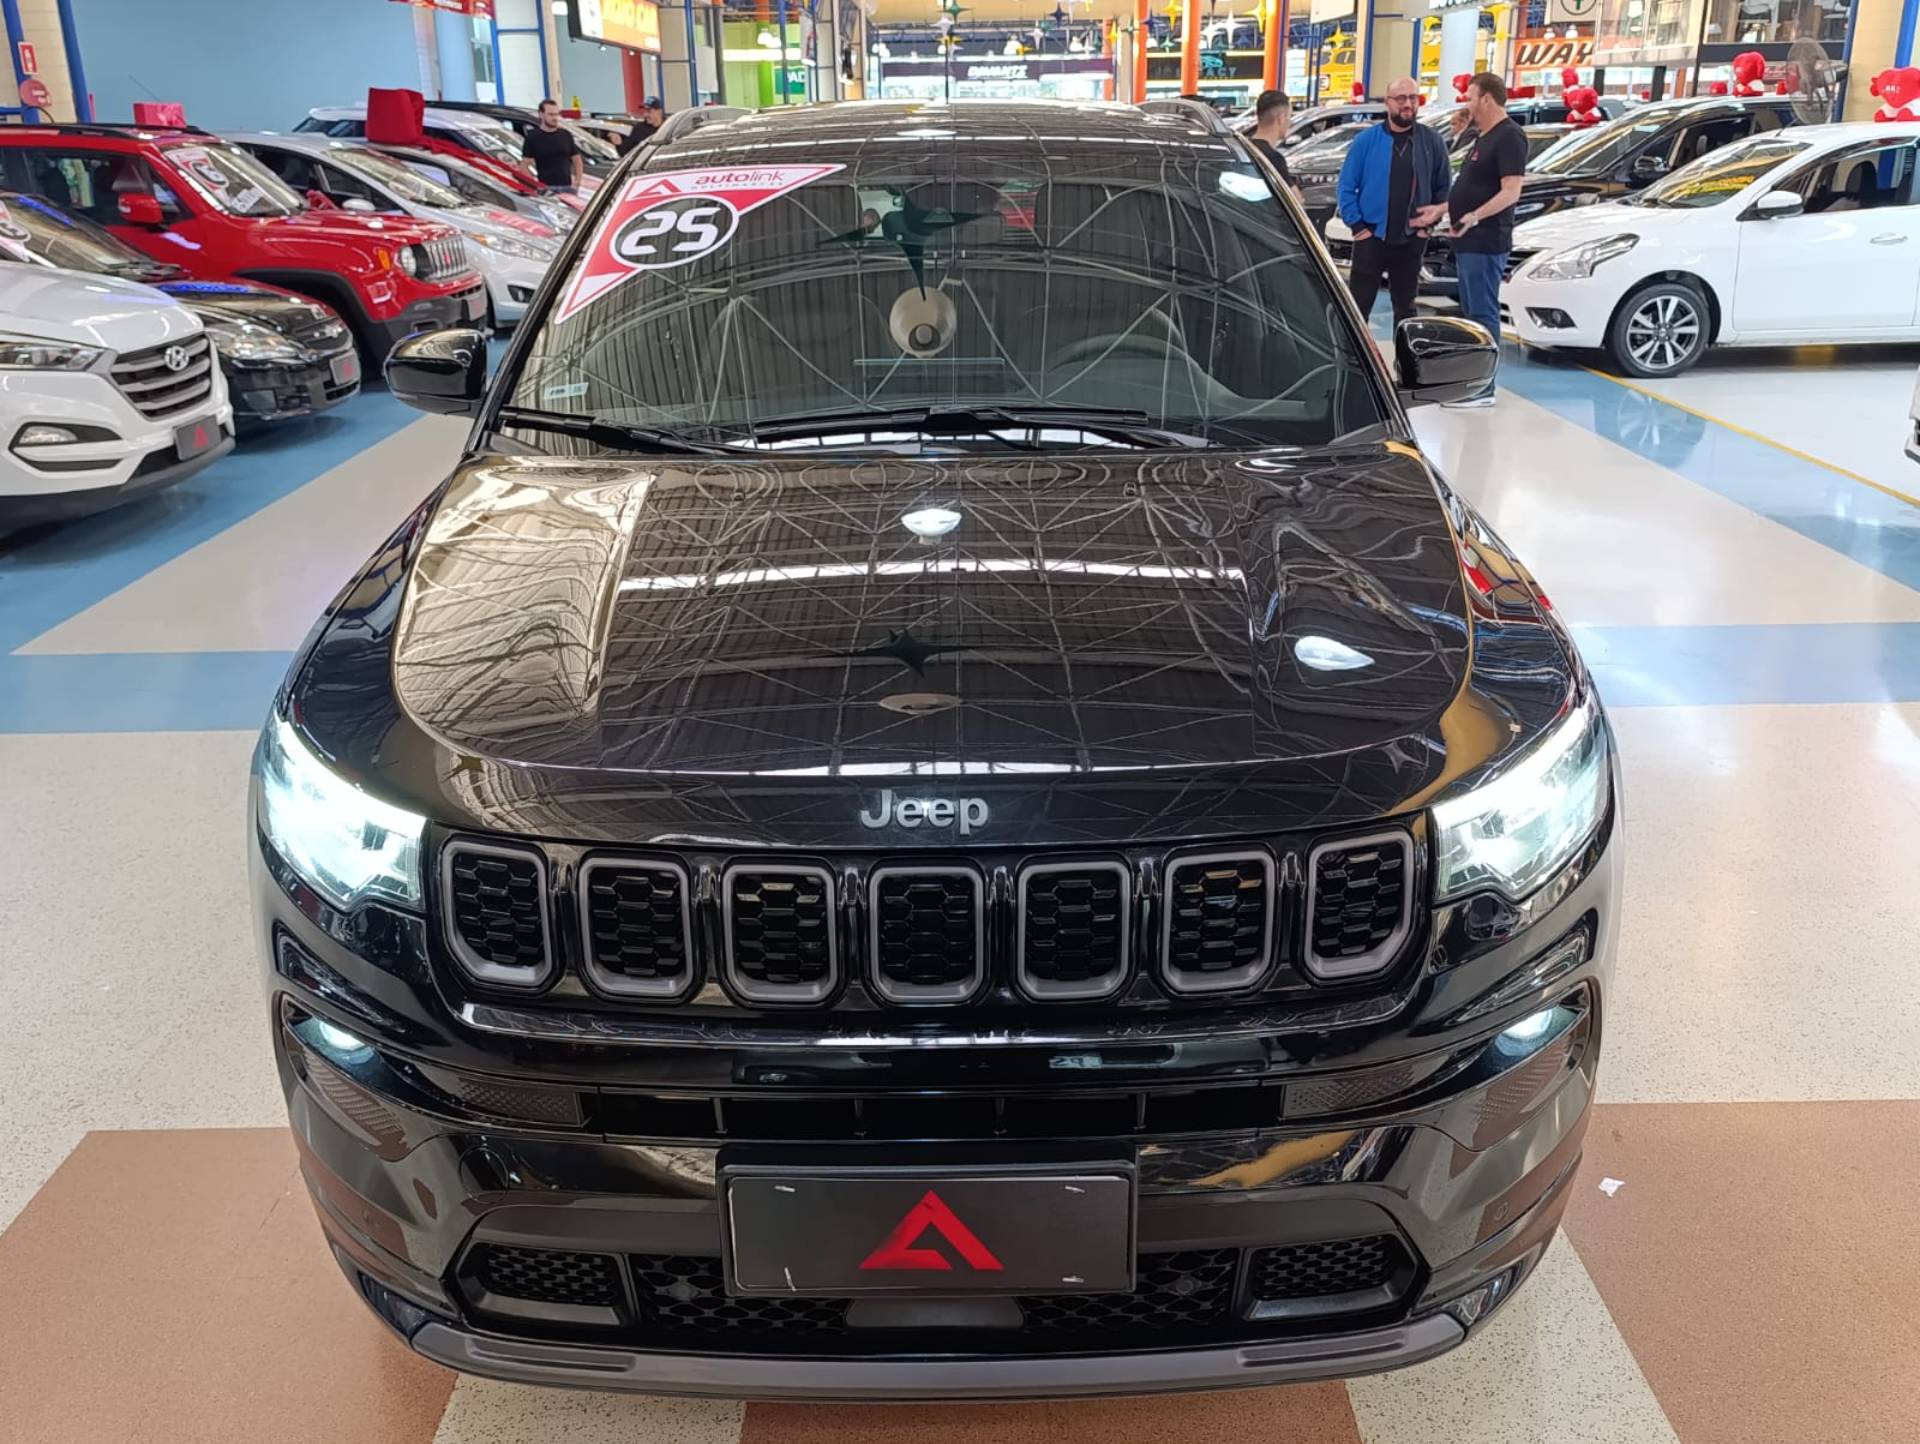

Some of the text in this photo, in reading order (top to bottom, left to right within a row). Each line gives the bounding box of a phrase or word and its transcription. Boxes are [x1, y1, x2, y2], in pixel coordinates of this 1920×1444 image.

[1516, 42, 1595, 66] WAY
[695, 171, 785, 185] autolink
[621, 207, 721, 256] 25
[860, 789, 989, 835] Jeep
